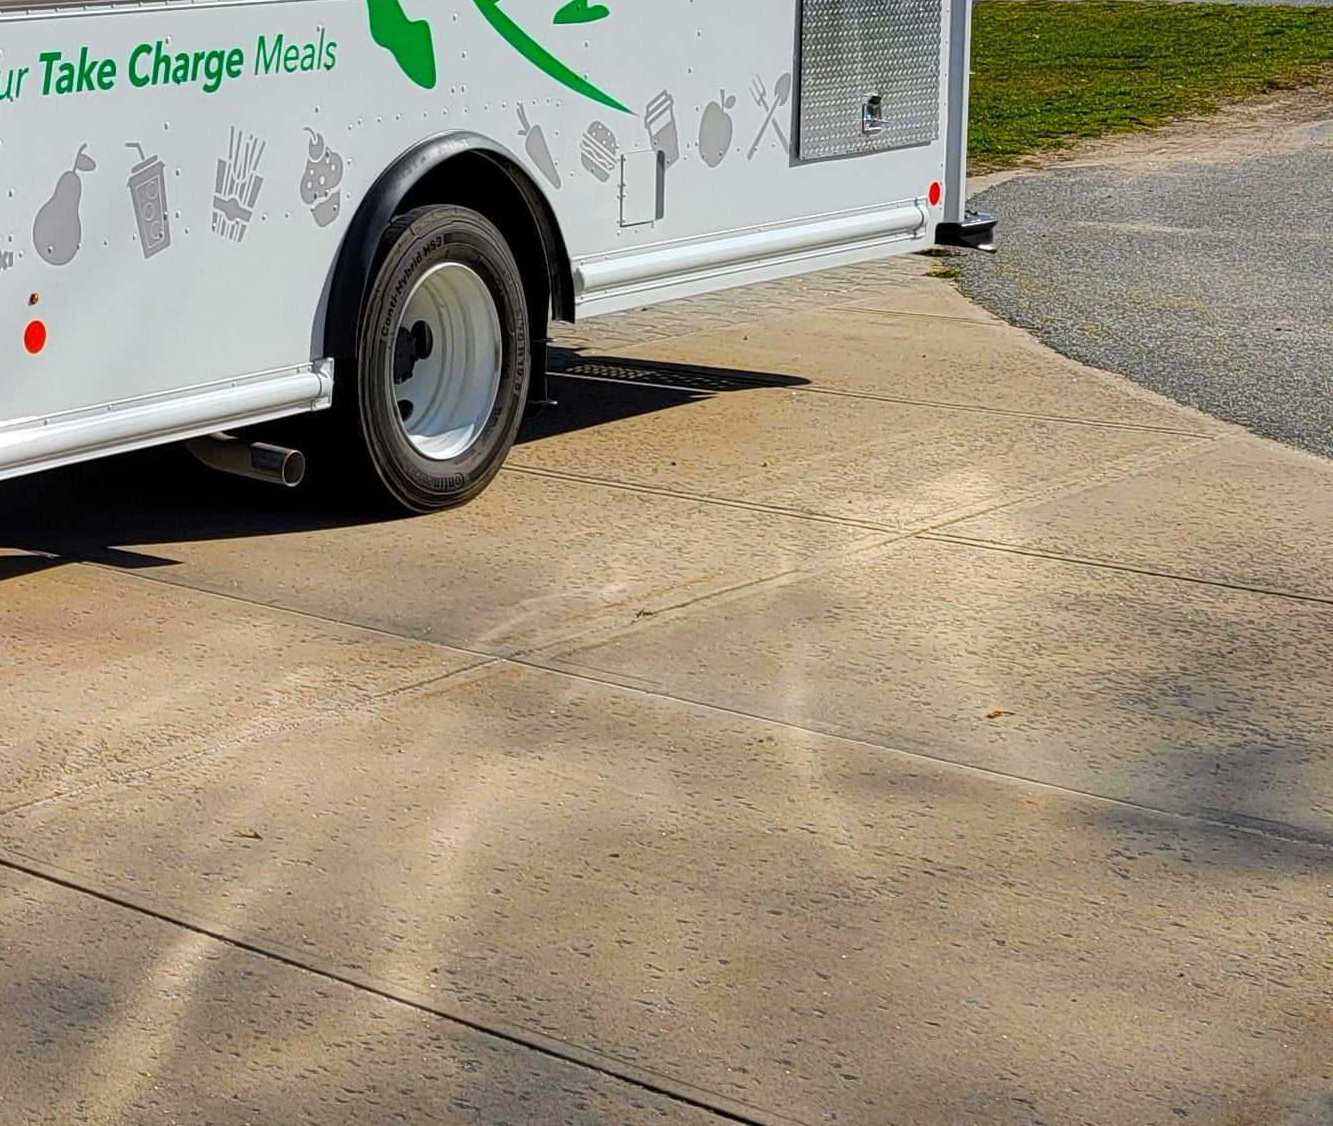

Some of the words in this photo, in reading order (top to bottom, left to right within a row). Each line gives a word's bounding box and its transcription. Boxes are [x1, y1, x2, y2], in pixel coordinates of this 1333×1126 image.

[38, 47, 117, 96] Take
[128, 40, 244, 94] Charge
[255, 30, 338, 74] Meals
[422, 235, 443, 256] HS3
